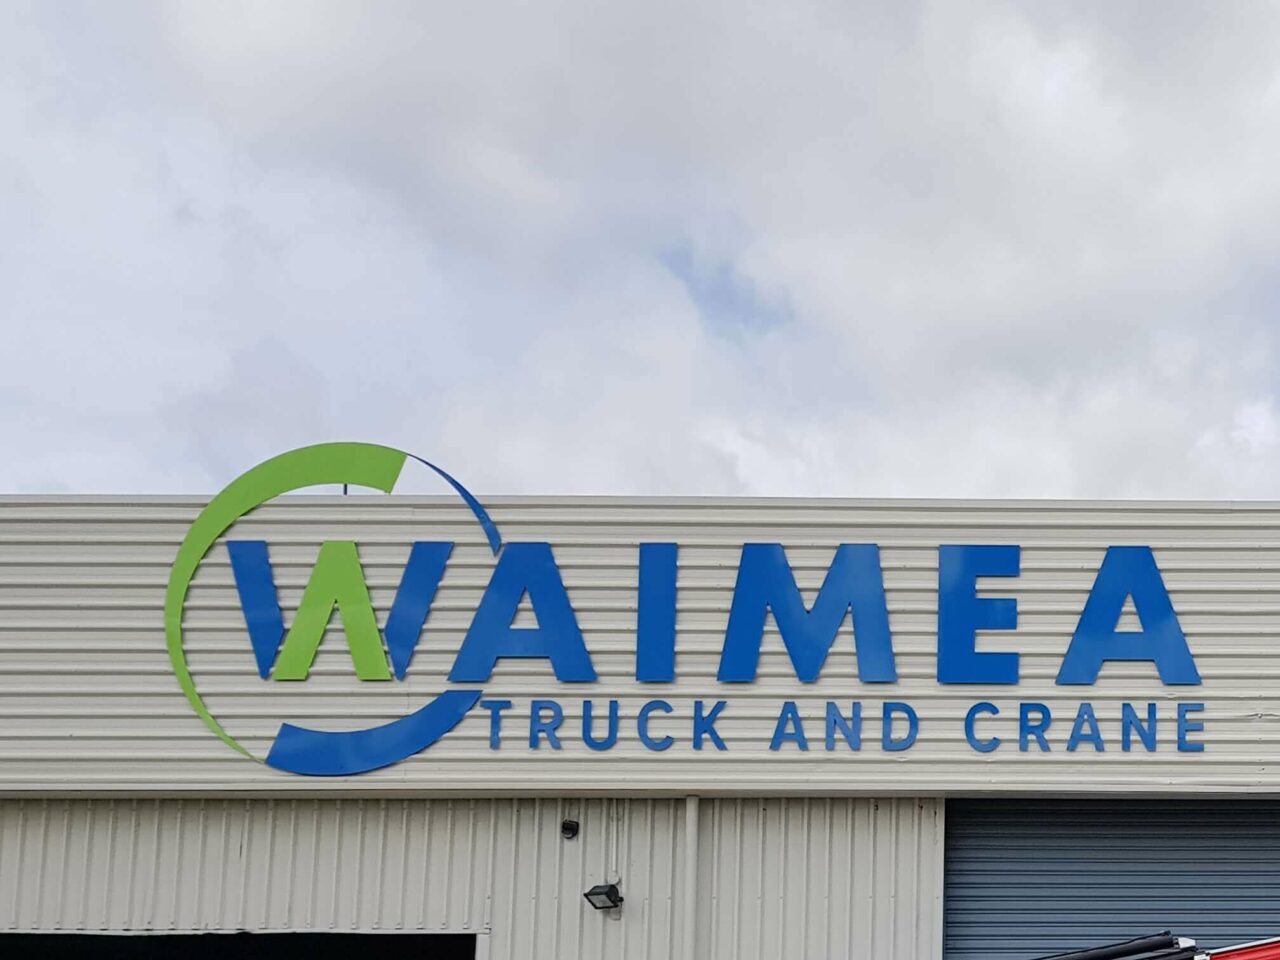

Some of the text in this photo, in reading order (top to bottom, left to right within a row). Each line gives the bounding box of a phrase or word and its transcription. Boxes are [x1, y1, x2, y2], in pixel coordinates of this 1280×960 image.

[226, 540, 1202, 685] WAIMEA
[480, 700, 1205, 752] TRUCK AND CRANE
